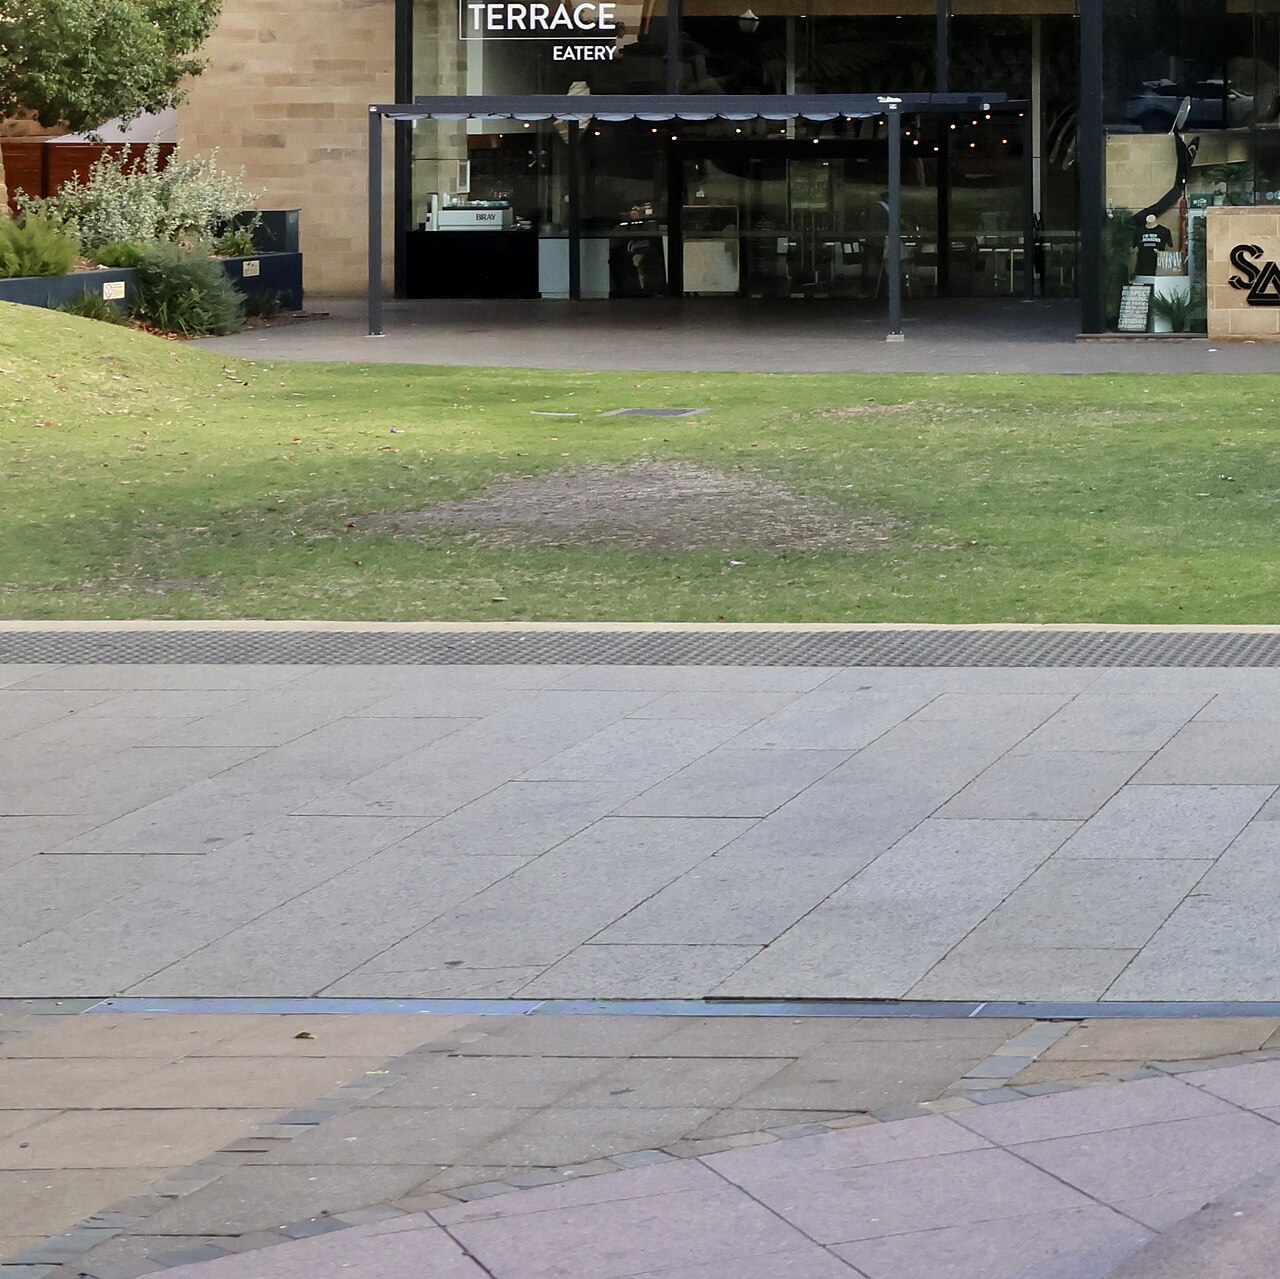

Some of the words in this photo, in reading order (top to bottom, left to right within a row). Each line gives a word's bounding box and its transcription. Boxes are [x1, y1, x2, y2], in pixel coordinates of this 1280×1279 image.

[468, 3, 616, 30] TERRACE
[553, 45, 617, 61] EATERY
[476, 213, 496, 221] BRAY
